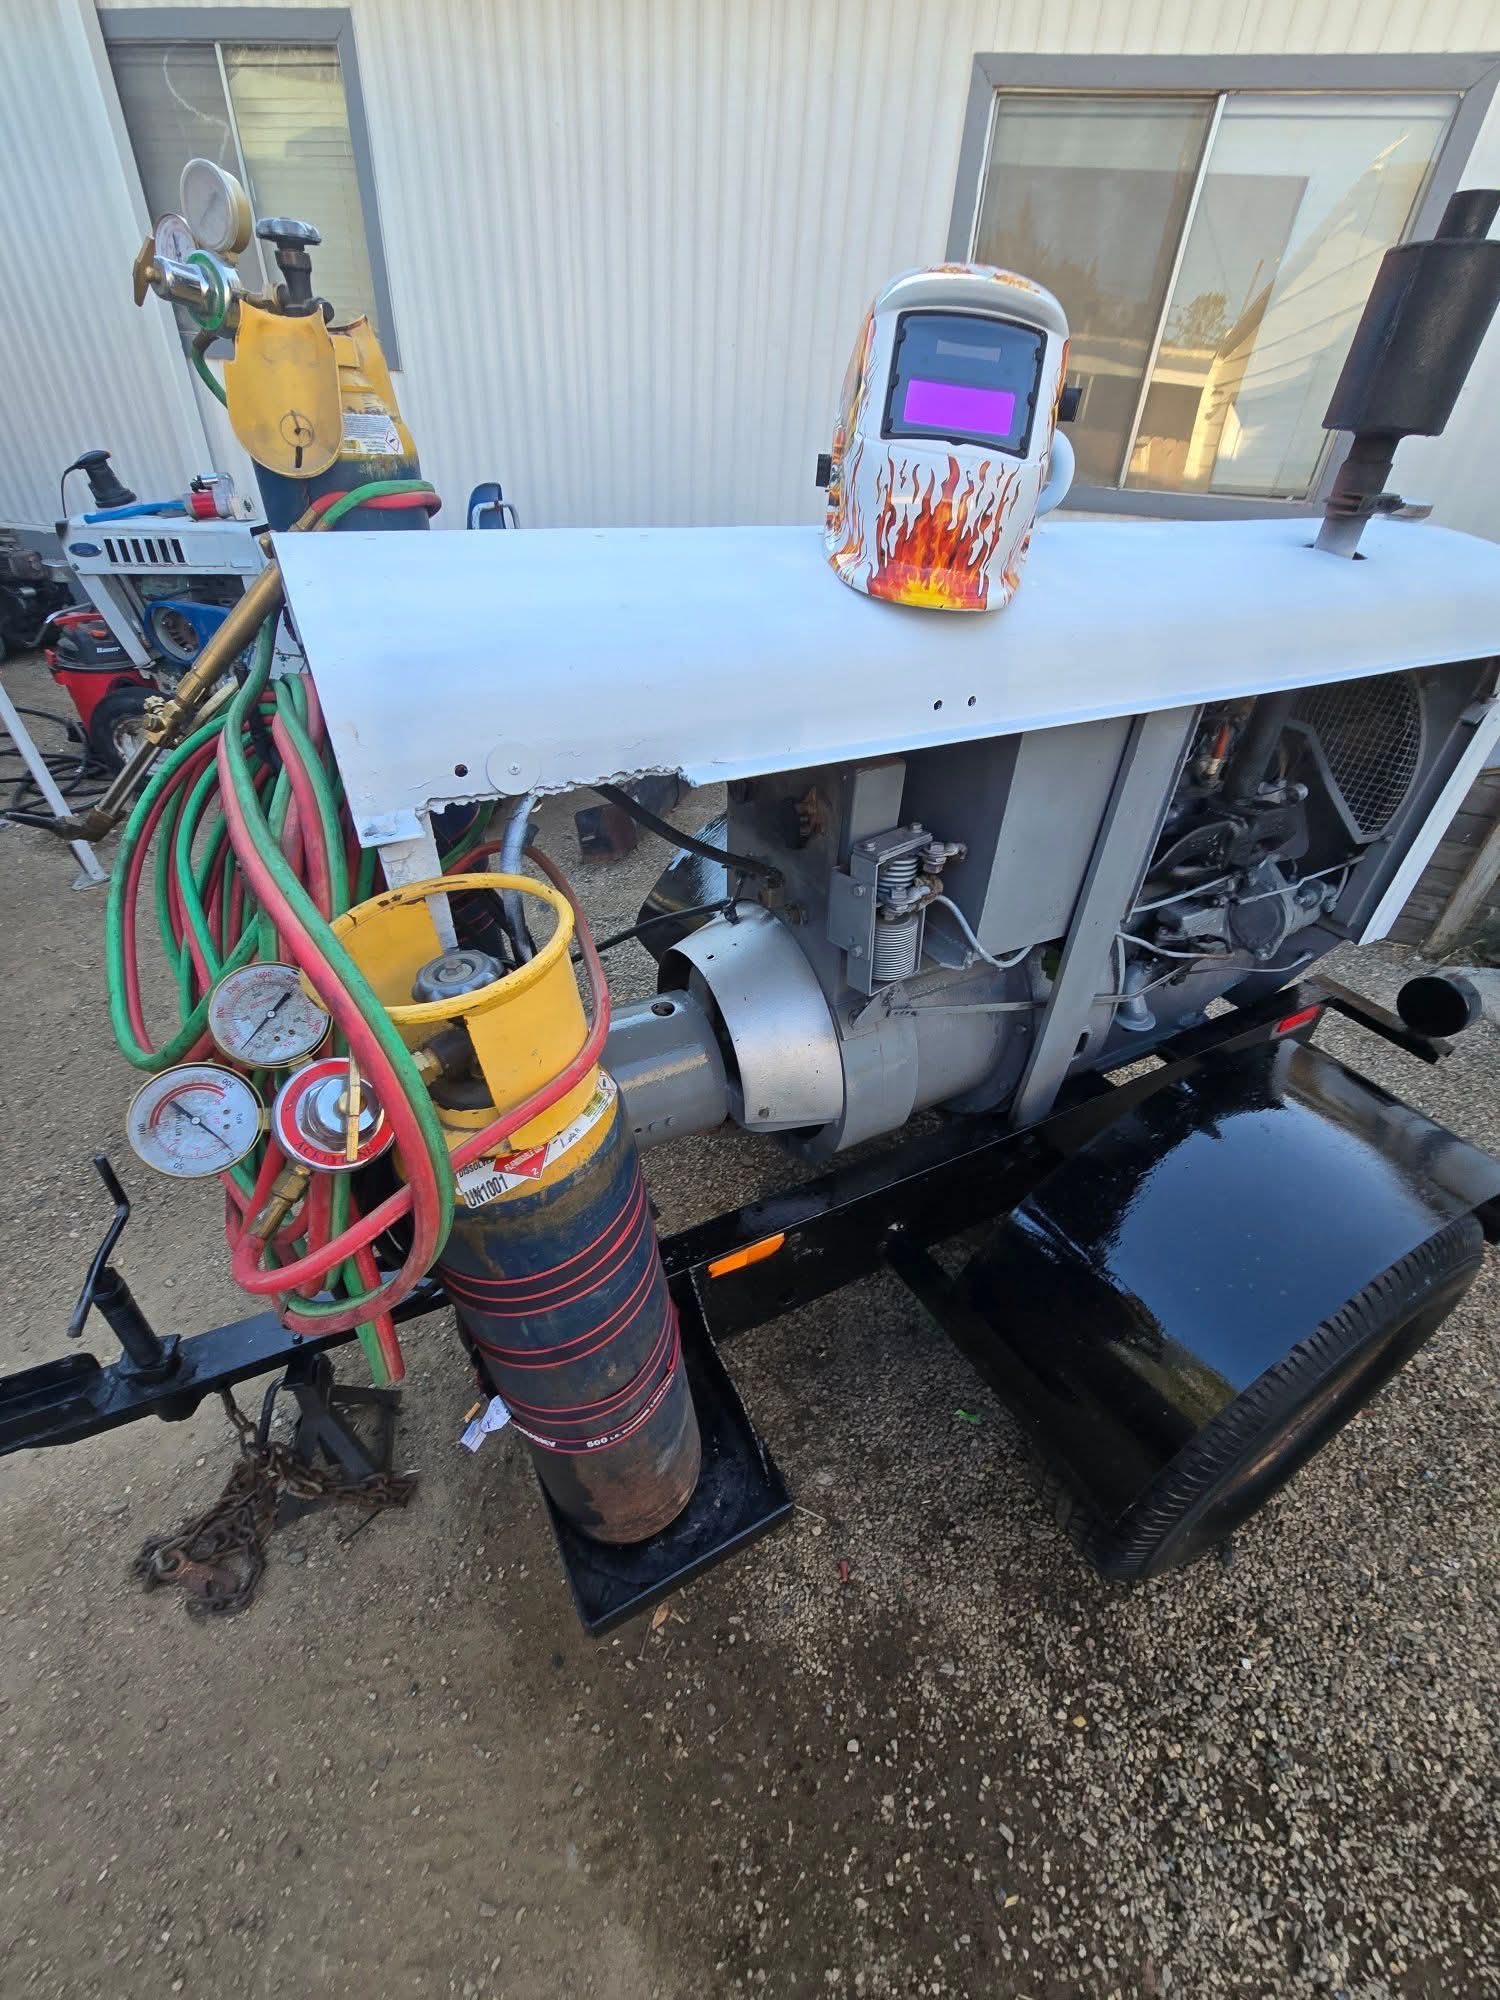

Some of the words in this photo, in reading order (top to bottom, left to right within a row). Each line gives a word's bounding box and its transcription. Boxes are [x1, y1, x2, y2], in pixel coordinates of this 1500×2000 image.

[531, 1167, 539, 1176] 2
[464, 1173, 509, 1207] UN1001
[586, 1437, 608, 1448] 500
